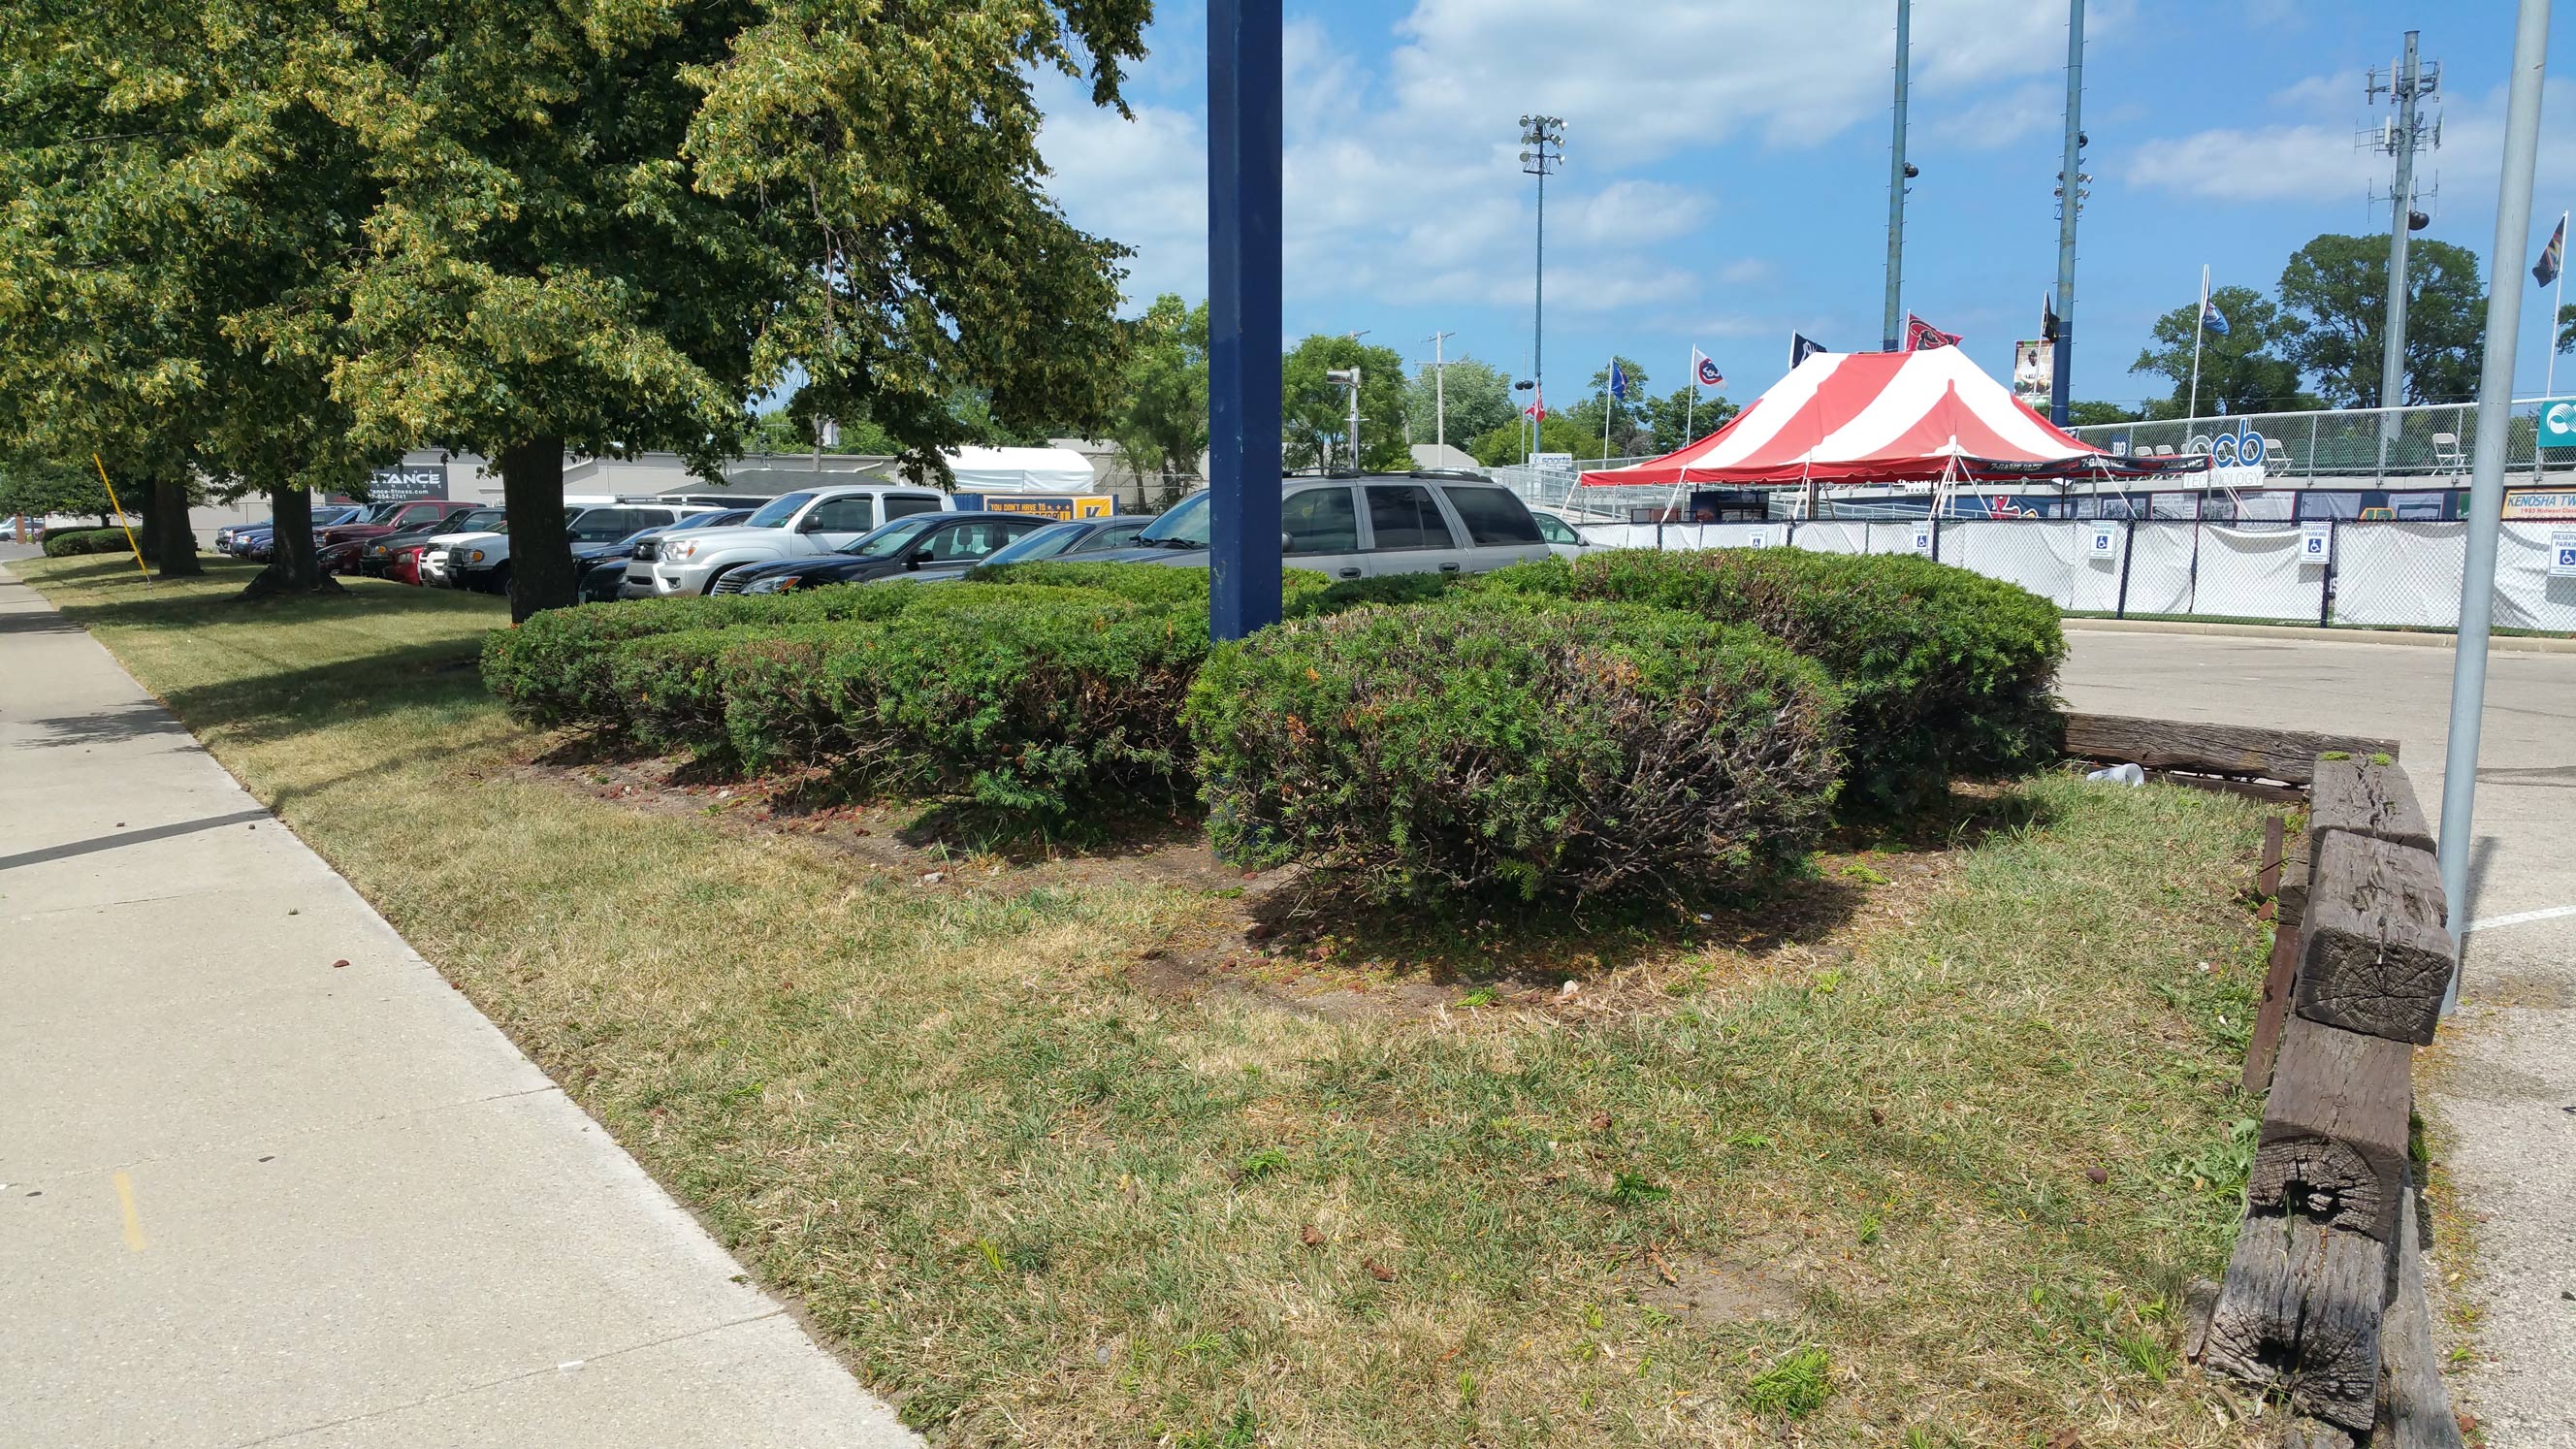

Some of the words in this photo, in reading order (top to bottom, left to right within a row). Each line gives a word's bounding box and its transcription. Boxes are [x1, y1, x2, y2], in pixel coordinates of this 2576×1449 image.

[371, 473, 441, 484] TANCE
[2186, 471, 2263, 488] TECHNOLOGY
[2507, 496, 2556, 506] KENOSHA
[1003, 503, 1020, 512] DON'T
[1021, 503, 1037, 512] HAVE
[1039, 502, 1046, 512] TO
